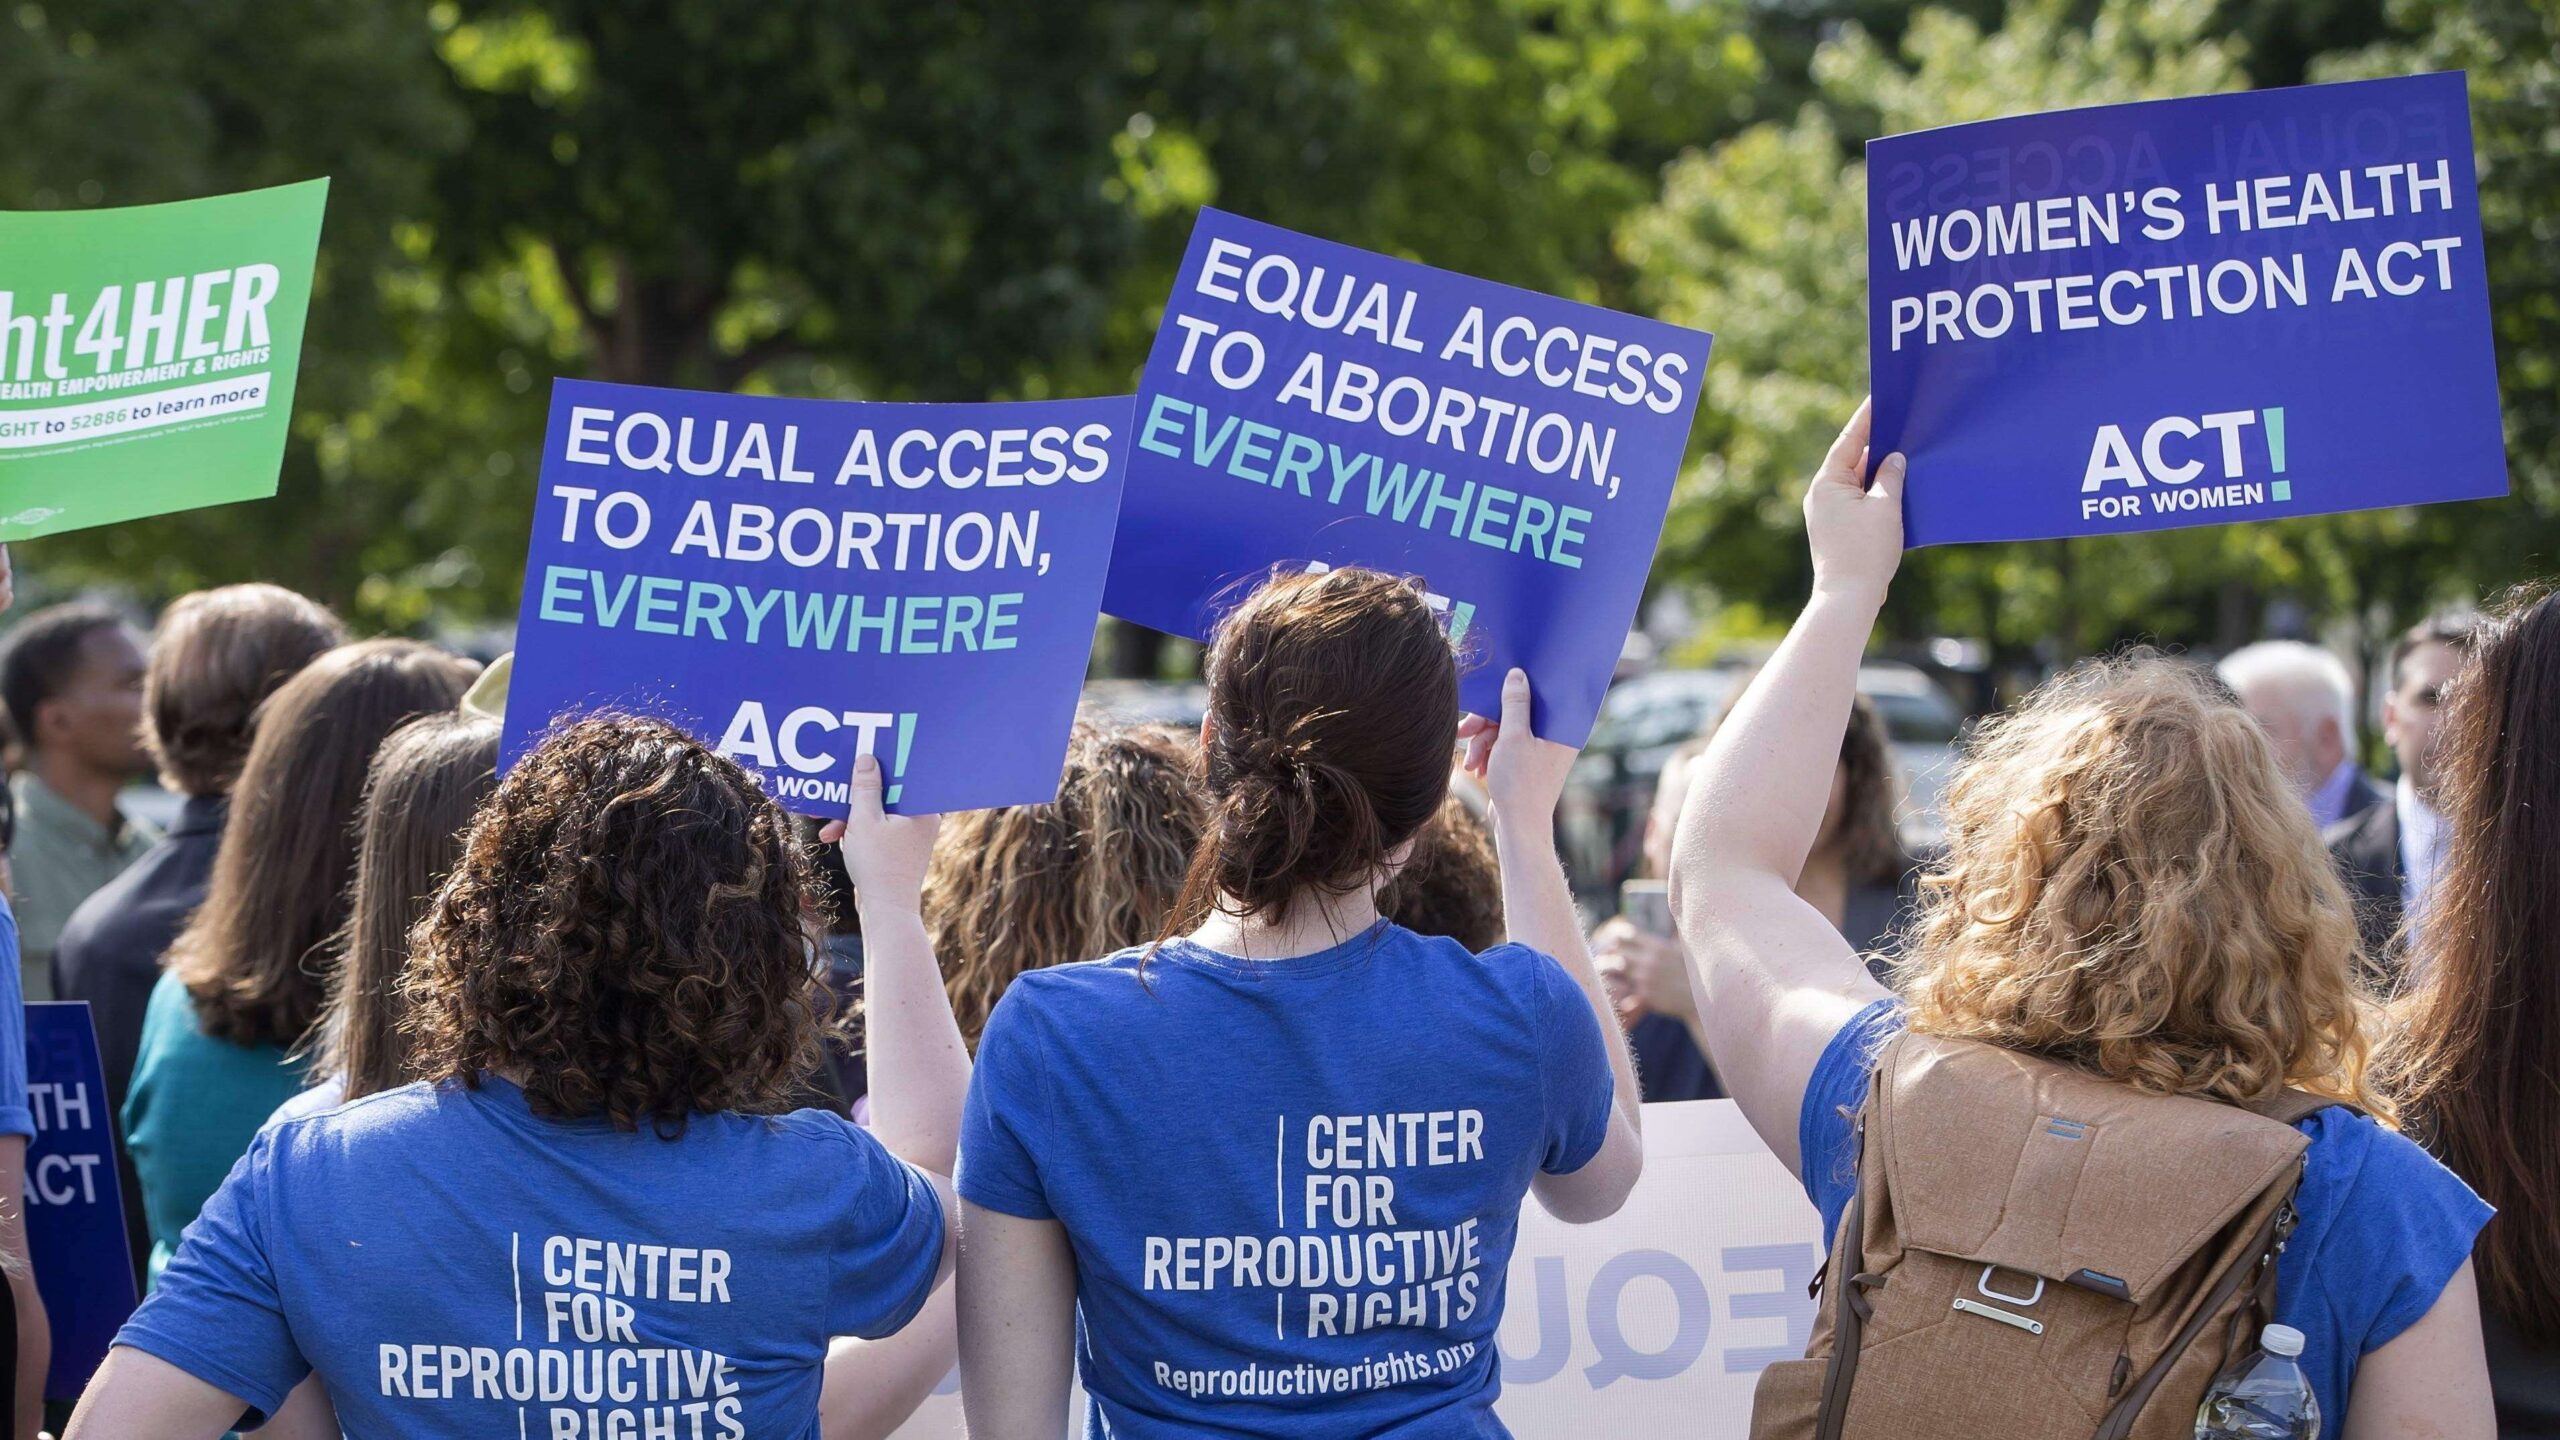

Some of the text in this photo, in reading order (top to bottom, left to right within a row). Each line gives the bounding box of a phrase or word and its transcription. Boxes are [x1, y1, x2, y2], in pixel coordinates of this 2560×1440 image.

[1891, 186, 2186, 271] WOMEN’S
[2205, 159, 2453, 235] HEALTH
[0, 263, 280, 381] ht4HER
[1195, 238, 1689, 415] EQUAL ACCESS
[1891, 253, 2308, 351] PROTECTION
[2331, 236, 2463, 302] ACT
[57, 361, 189, 397] EMPOWERMENT
[193, 358, 206, 375] &
[212, 346, 270, 371] RIGHTS
[45, 420, 65, 433] to
[70, 409, 127, 430] 52886
[132, 407, 151, 419] to
[156, 397, 205, 416] learn
[210, 386, 260, 405] more
[1175, 315, 1622, 500] TO ABORTION,
[565, 406, 1113, 489] EQUAL ACCESS
[1138, 393, 1593, 569] EVERYWHERE
[2081, 406, 2292, 501] ACT!
[552, 486, 1051, 576] TO ABORTION,
[2082, 482, 2264, 520] FOR WOMEN
[539, 566, 1025, 655] EVERYWHERE
[715, 700, 918, 805] ACT!
[776, 775, 852, 805] WOM
[1307, 1109, 1484, 1169] CENTER
[1306, 1175, 1397, 1228] FOR
[543, 1235, 731, 1303] CENTER
[1144, 1217, 1481, 1290] REPRODUCTIVE
[544, 1292, 640, 1343] FOR
[1307, 1271, 1480, 1338] RIGHTS
[379, 1343, 740, 1403] REPRODUCTIVE
[1154, 1340, 1475, 1398] Reproductiverights.org
[550, 1397, 745, 1440] RIGHTS
